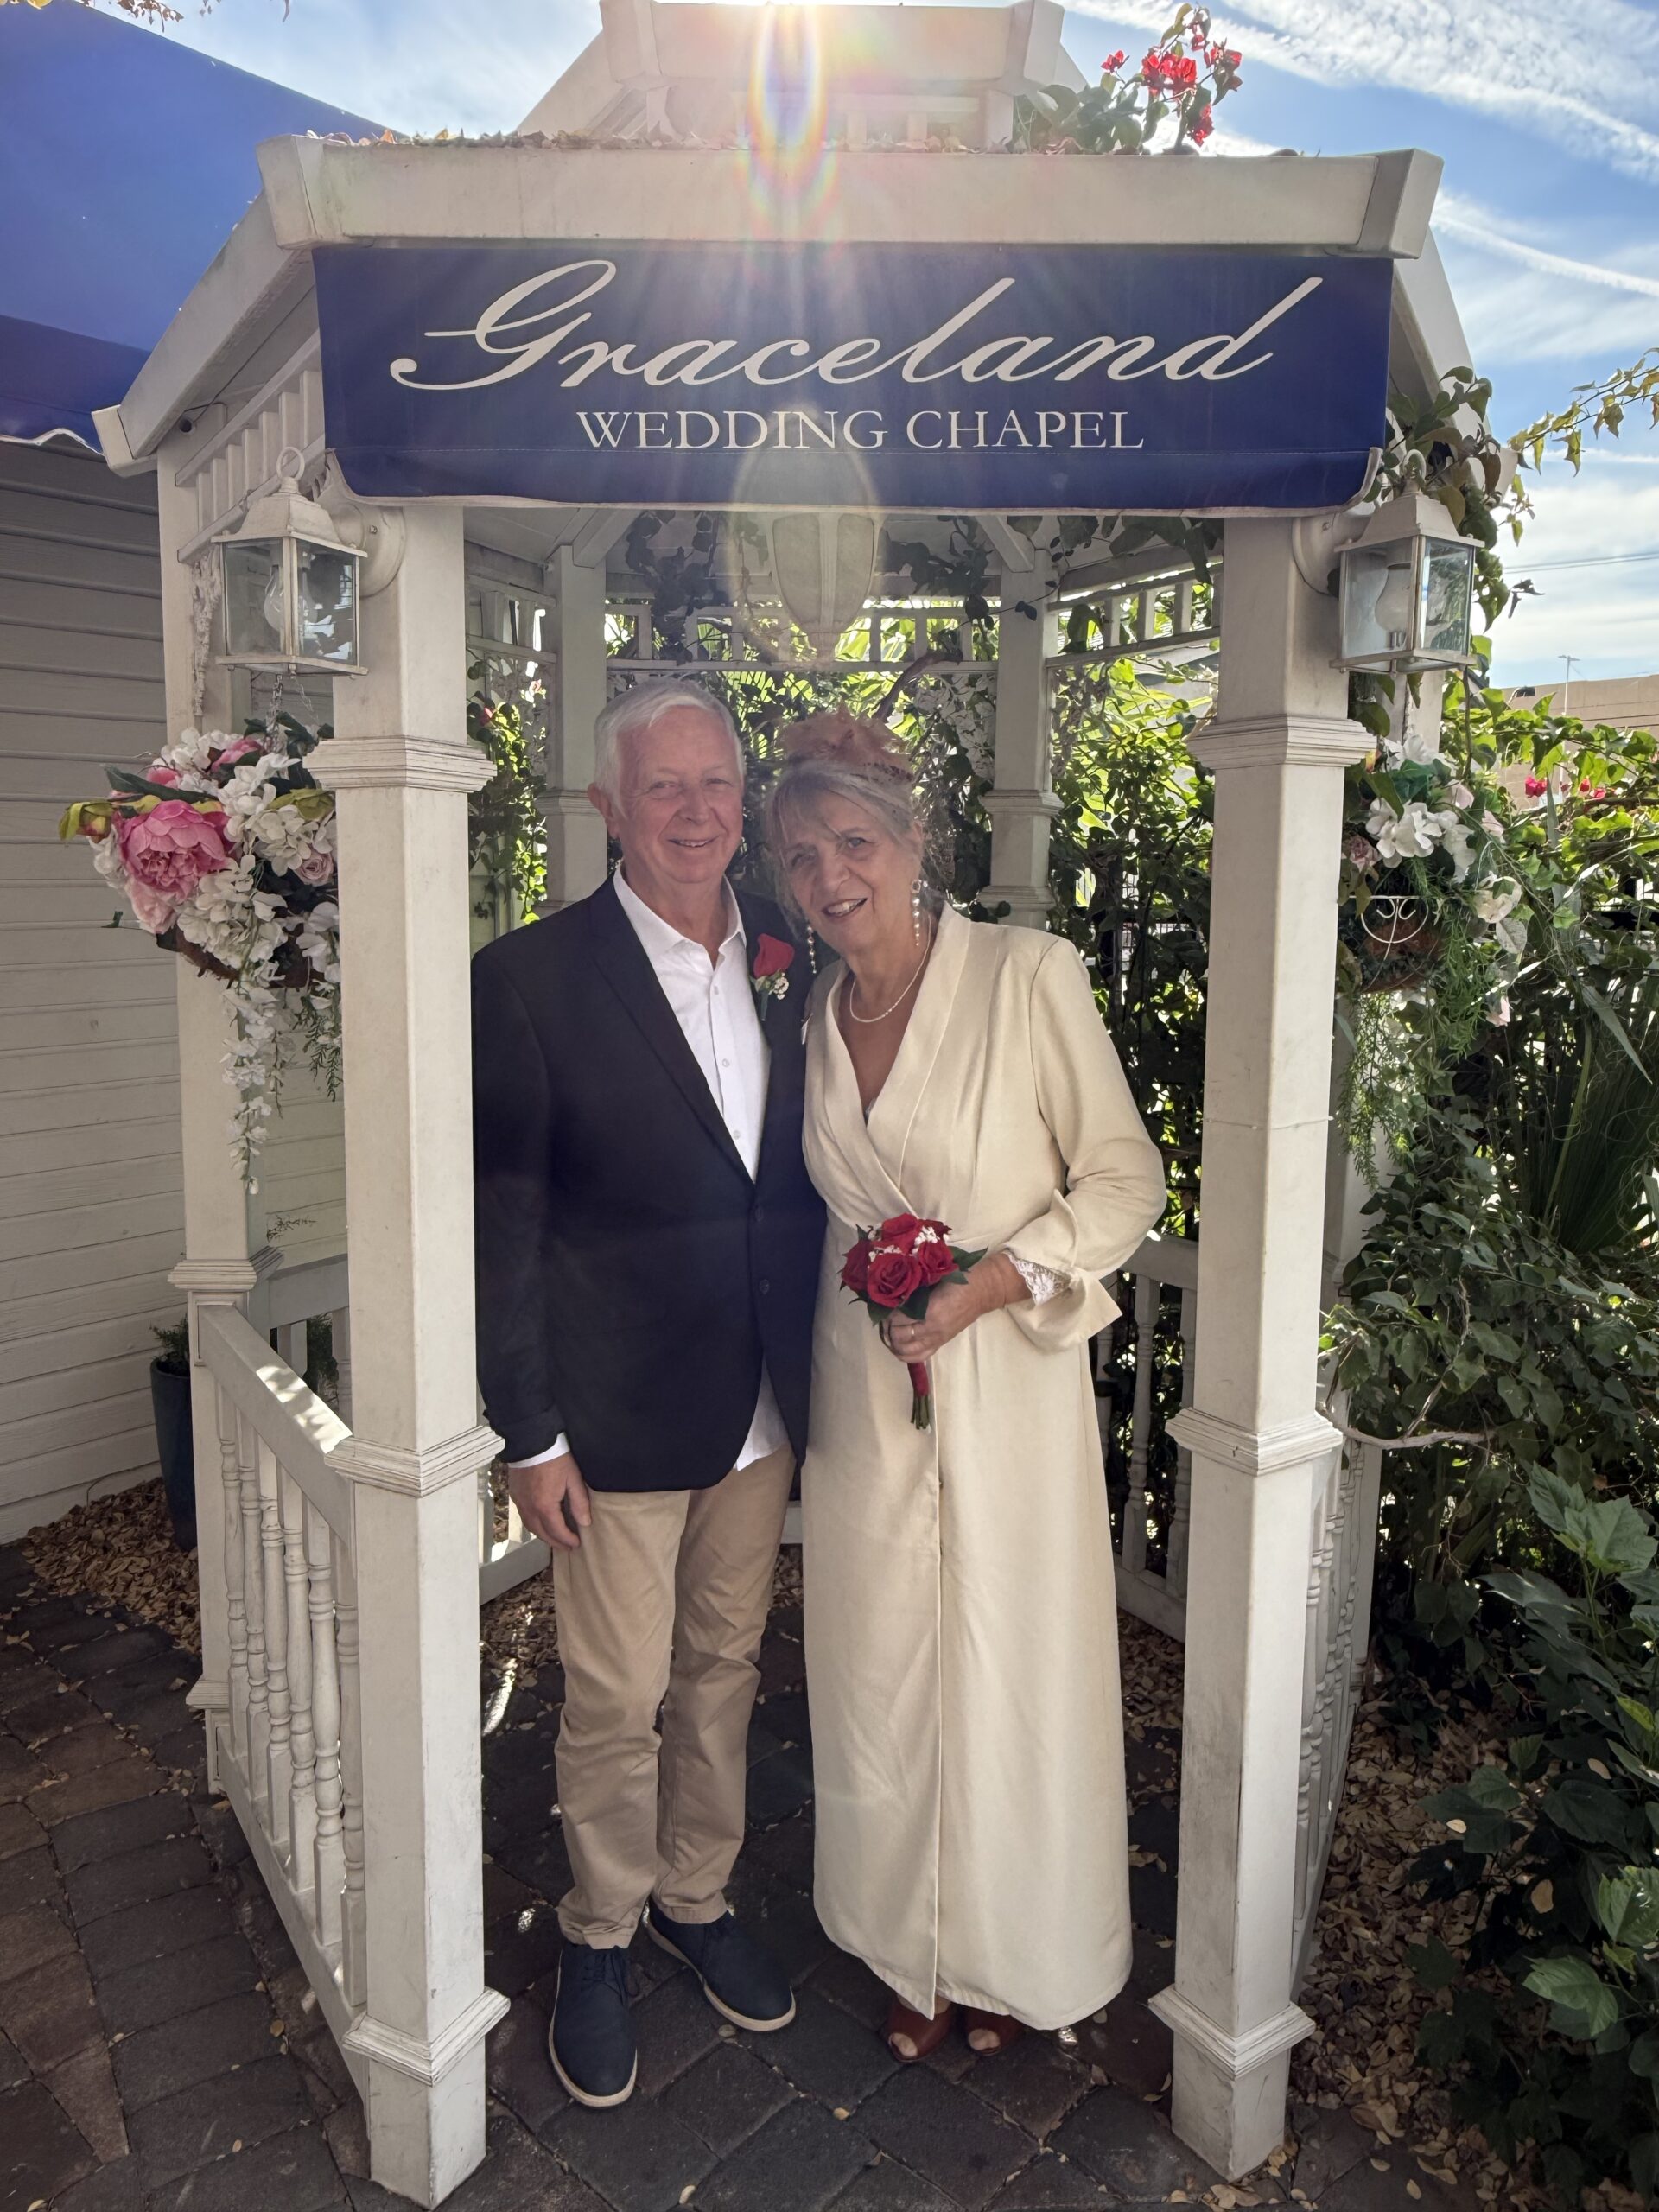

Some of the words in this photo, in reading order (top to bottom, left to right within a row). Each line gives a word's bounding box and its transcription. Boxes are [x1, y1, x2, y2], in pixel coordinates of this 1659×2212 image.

[390, 260, 1323, 389] Graceland
[576, 410, 888, 449] WEDDING
[906, 410, 1144, 449] CHAPEL
